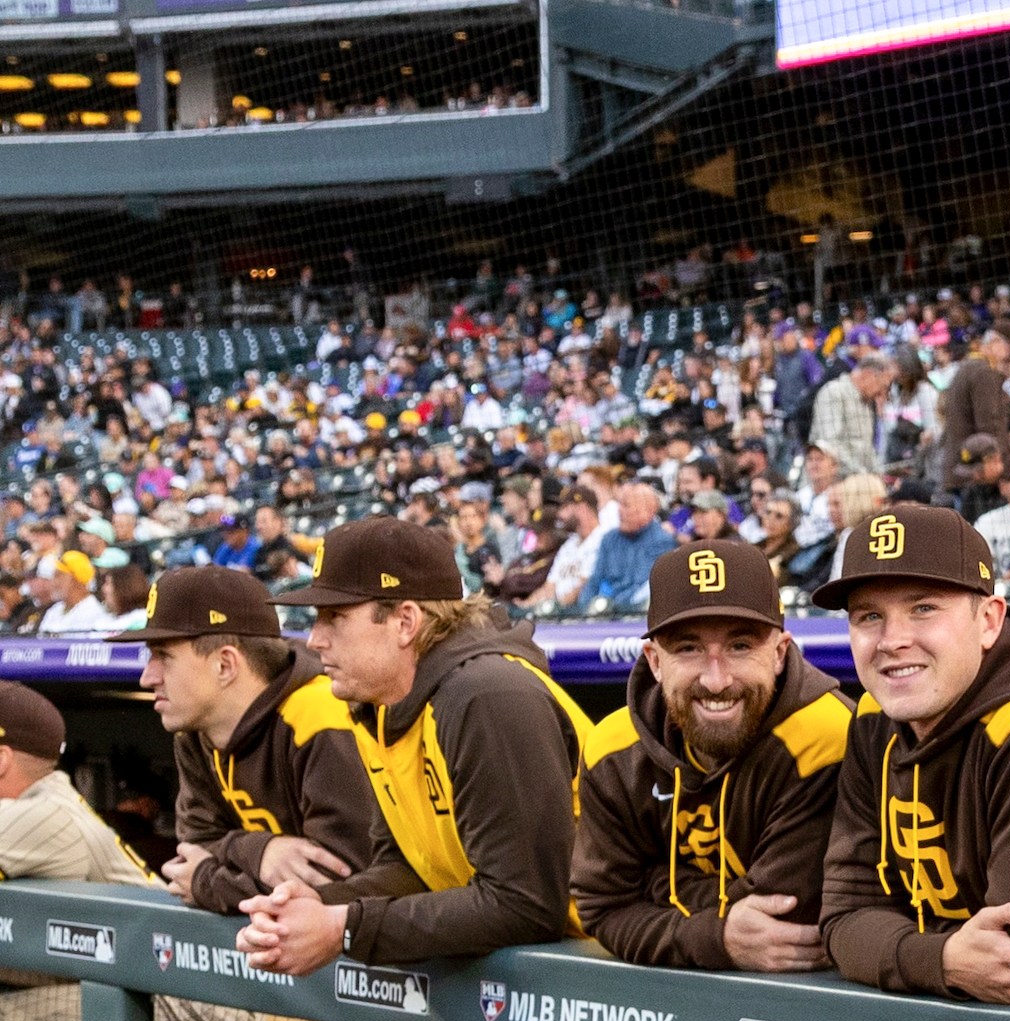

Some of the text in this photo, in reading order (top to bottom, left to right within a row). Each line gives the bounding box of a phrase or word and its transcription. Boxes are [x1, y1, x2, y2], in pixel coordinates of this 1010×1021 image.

[49, 925, 96, 953] MLB.com
[175, 941, 210, 971] MLB
[338, 968, 403, 1002] MLB.com
